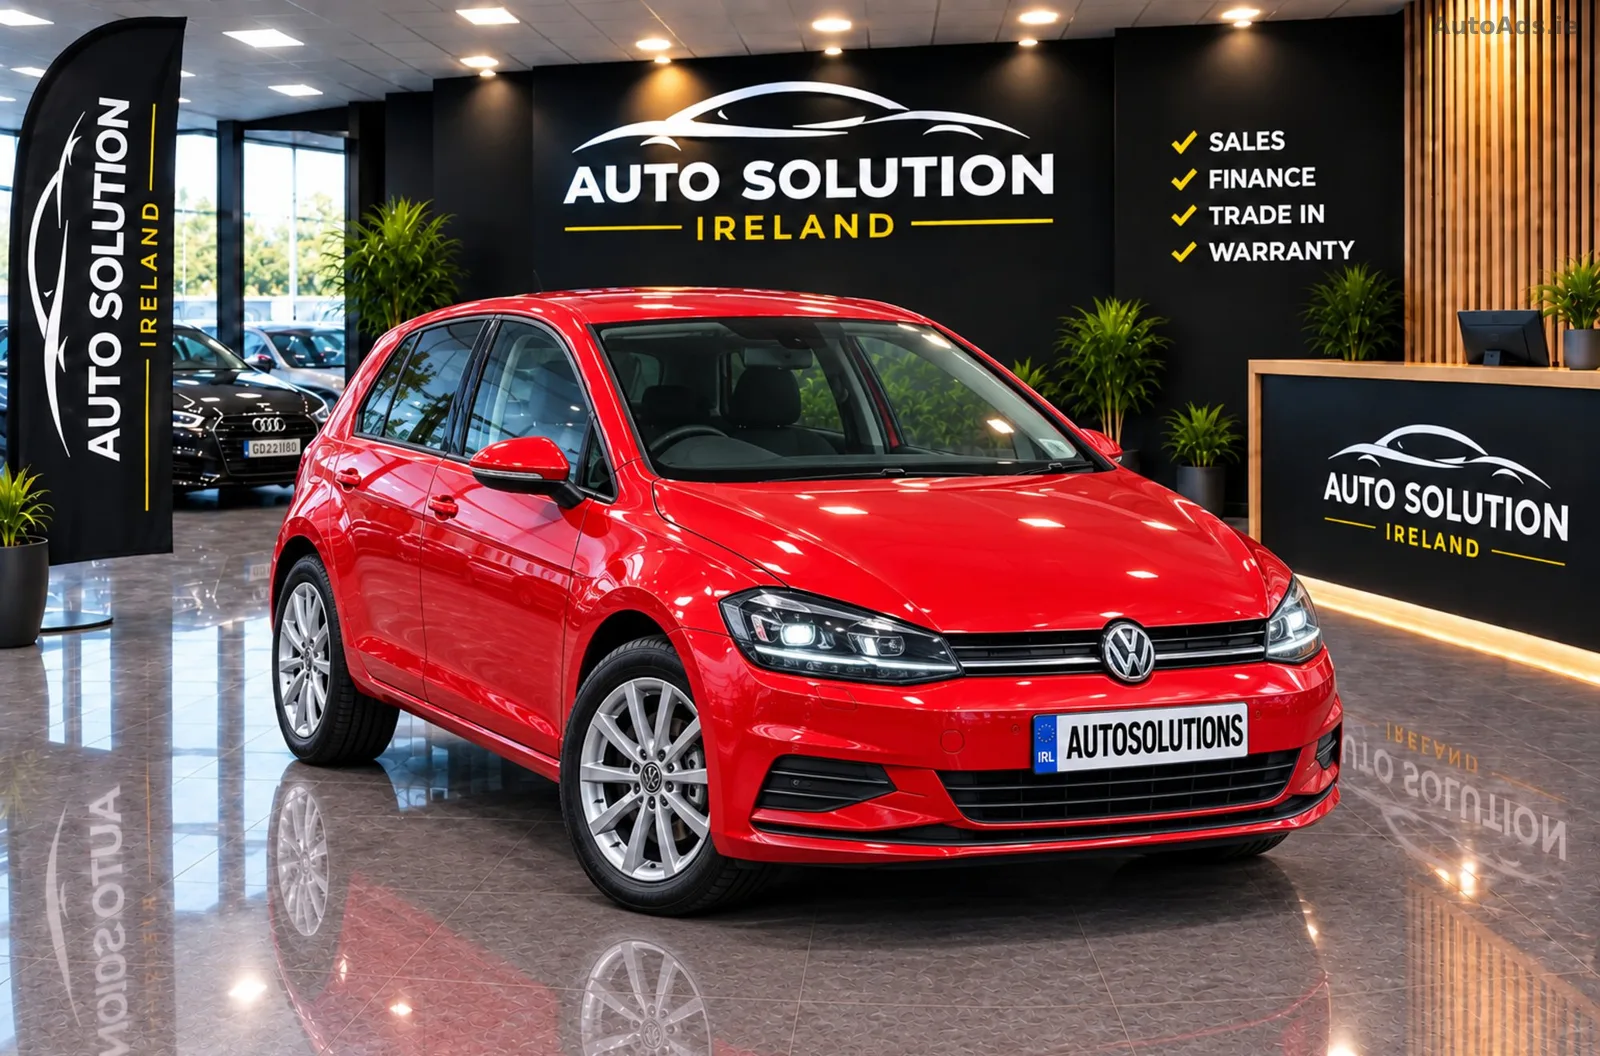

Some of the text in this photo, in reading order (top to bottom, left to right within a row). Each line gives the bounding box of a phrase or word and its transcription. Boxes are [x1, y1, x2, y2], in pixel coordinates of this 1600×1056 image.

[1209, 130, 1286, 152] SALES
[563, 153, 1053, 204] AUTO SOLUTION
[1208, 167, 1317, 190] FINANCE
[696, 213, 895, 241] IRELAND
[1209, 204, 1325, 226] TRADE IN
[1208, 240, 1355, 262] WARRANTY
[88, 97, 130, 461] AUTO SOLUTION
[140, 202, 160, 348] IRELAND
[1324, 472, 1569, 542] AUTO SOLUTION
[1386, 523, 1479, 558] IRELAND
[1066, 713, 1244, 760] AUTOSOLUTIONS
[1037, 751, 1055, 763] IRL
